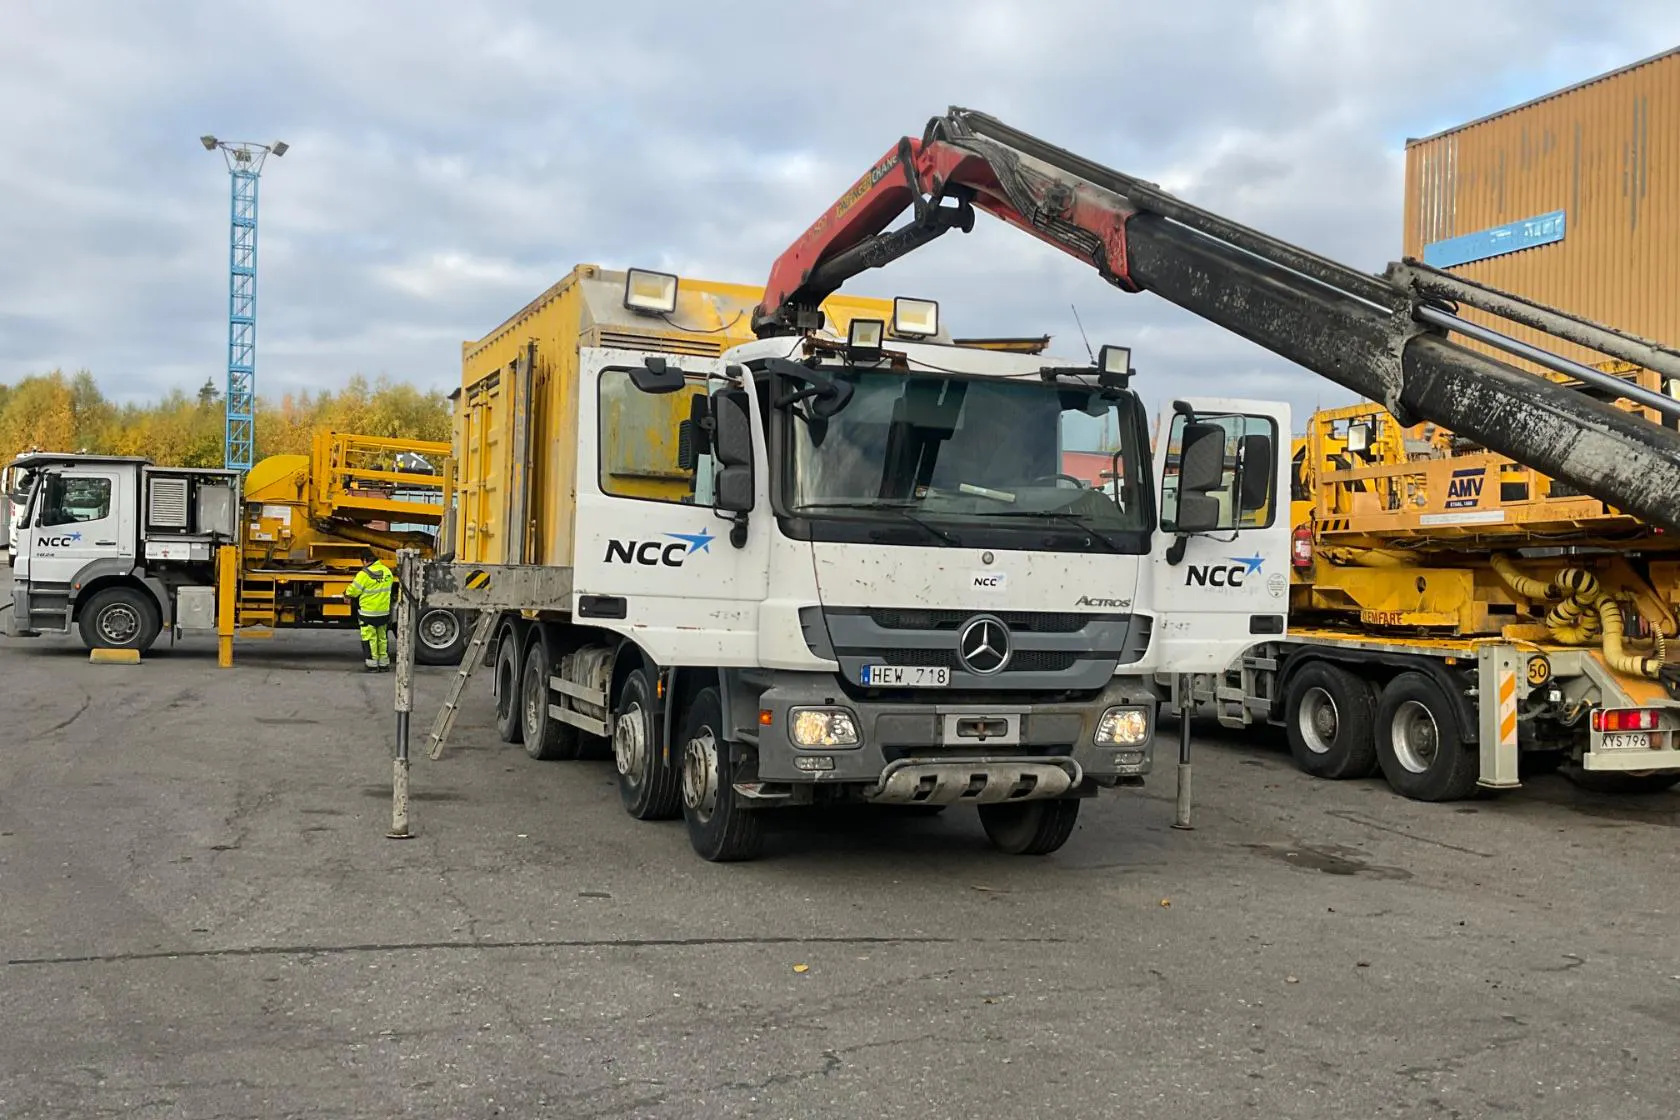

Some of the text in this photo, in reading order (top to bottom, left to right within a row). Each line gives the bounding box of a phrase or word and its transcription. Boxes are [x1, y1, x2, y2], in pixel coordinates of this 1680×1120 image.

[1448, 478, 1484, 498] AMV
[37, 537, 71, 547] NCC
[603, 539, 687, 567] NCC
[974, 578, 997, 587] NCC
[1185, 565, 1245, 587] NCC
[873, 668, 945, 684] HEW 718
[1529, 663, 1546, 679] 50
[1602, 734, 1646, 747] XYS 796
